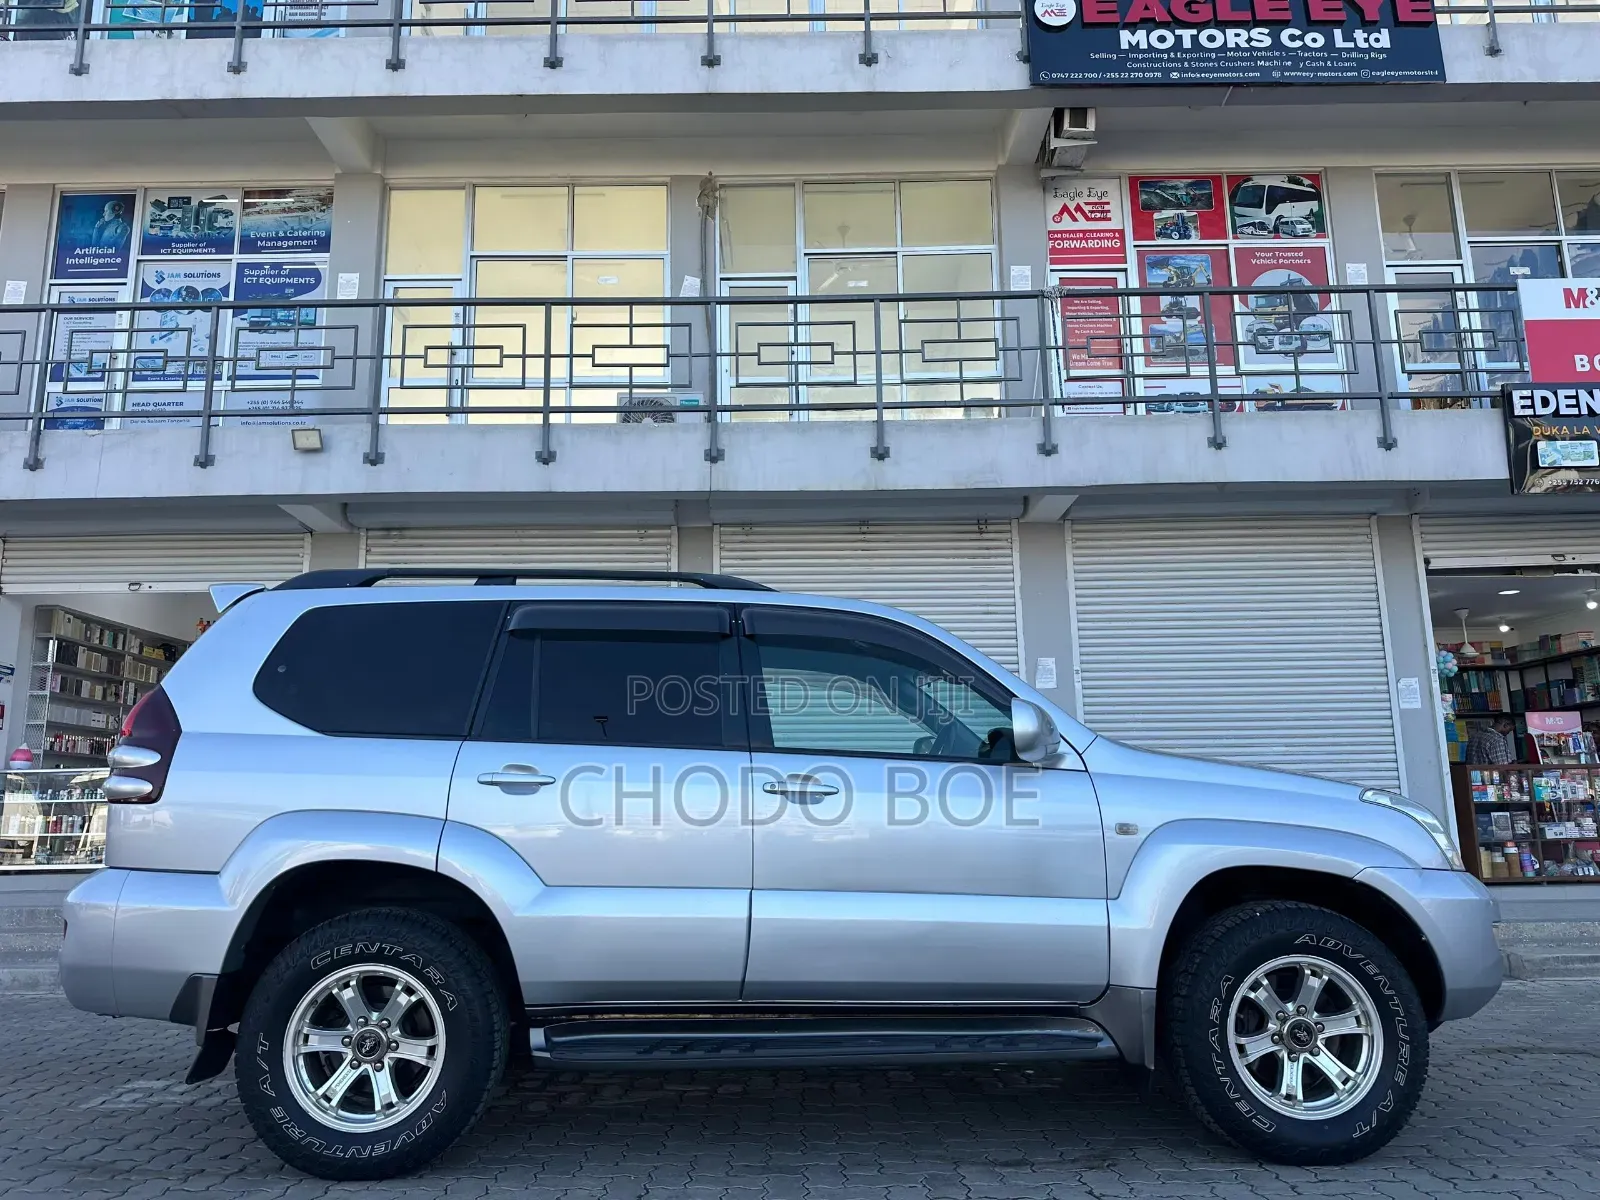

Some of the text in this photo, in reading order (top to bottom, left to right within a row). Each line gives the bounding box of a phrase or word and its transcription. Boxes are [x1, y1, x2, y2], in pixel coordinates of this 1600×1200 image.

[1081, 0, 1434, 22] EAGLE EYE
[1119, 28, 1391, 49] MOTORS Co Ltd
[1053, 187, 1108, 201] Eagle Eye
[257, 239, 318, 248] Management
[286, 230, 326, 238] Catering
[1049, 240, 1120, 248] FORWARDING
[66, 256, 122, 266] Intelligence
[244, 268, 279, 276] Supplier
[1563, 288, 1600, 308] M&
[1512, 389, 1600, 416] EDEN
[1533, 426, 1570, 435] DUKA
[1574, 426, 1590, 434] LA
[311, 942, 458, 1011] CENTARA
[1295, 934, 1410, 1138] ADVENTURE A/T
[1209, 975, 1276, 1132] CENTARA
[256, 1033, 276, 1096] A/T
[270, 1090, 447, 1158] ADVENTURE
